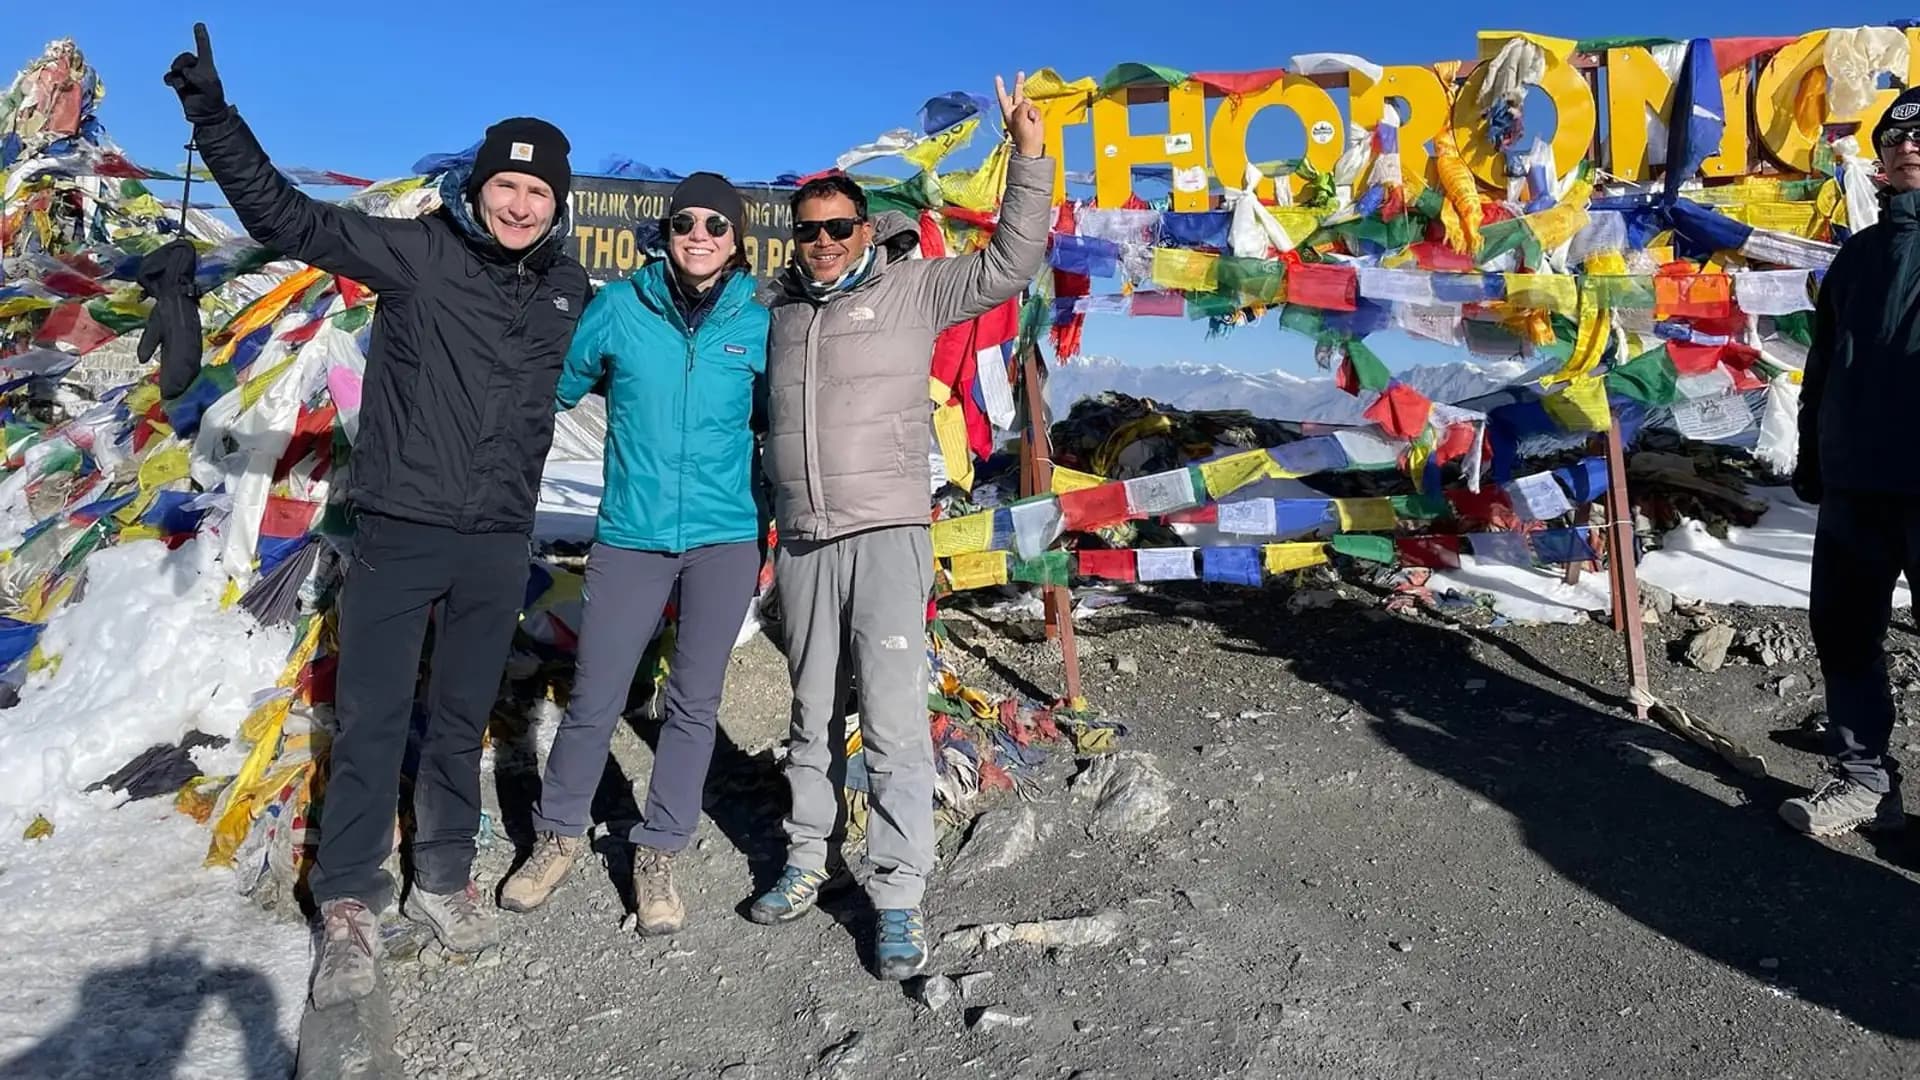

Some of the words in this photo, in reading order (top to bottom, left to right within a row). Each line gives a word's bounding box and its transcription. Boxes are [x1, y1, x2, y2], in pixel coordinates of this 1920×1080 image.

[575, 190, 630, 221] THANK
[633, 194, 664, 219] YOU
[576, 225, 646, 270] THO
